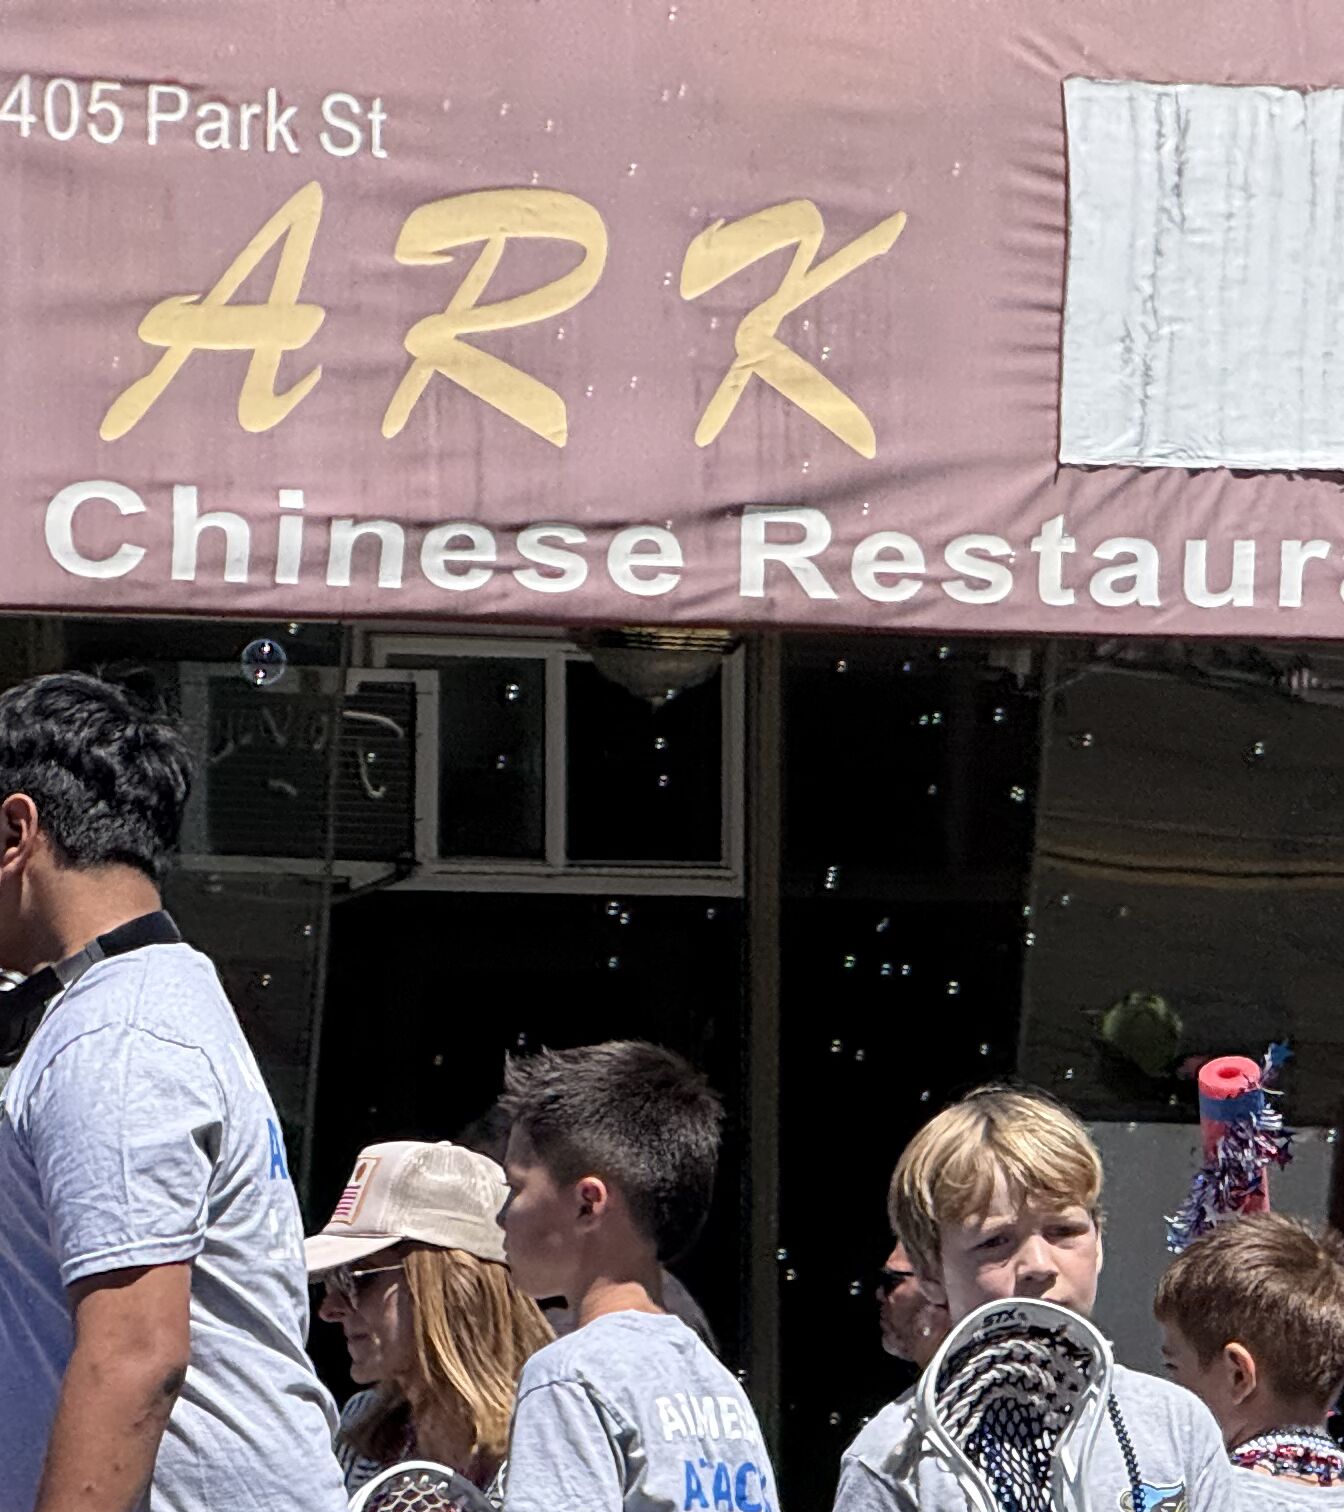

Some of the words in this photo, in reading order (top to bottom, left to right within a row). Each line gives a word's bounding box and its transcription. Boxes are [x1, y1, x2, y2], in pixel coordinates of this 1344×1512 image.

[146, 86, 300, 154] Park
[319, 92, 389, 158] St
[99, 180, 906, 460] ARK
[43, 481, 684, 597] Chinese
[738, 505, 1344, 612] Restaur
